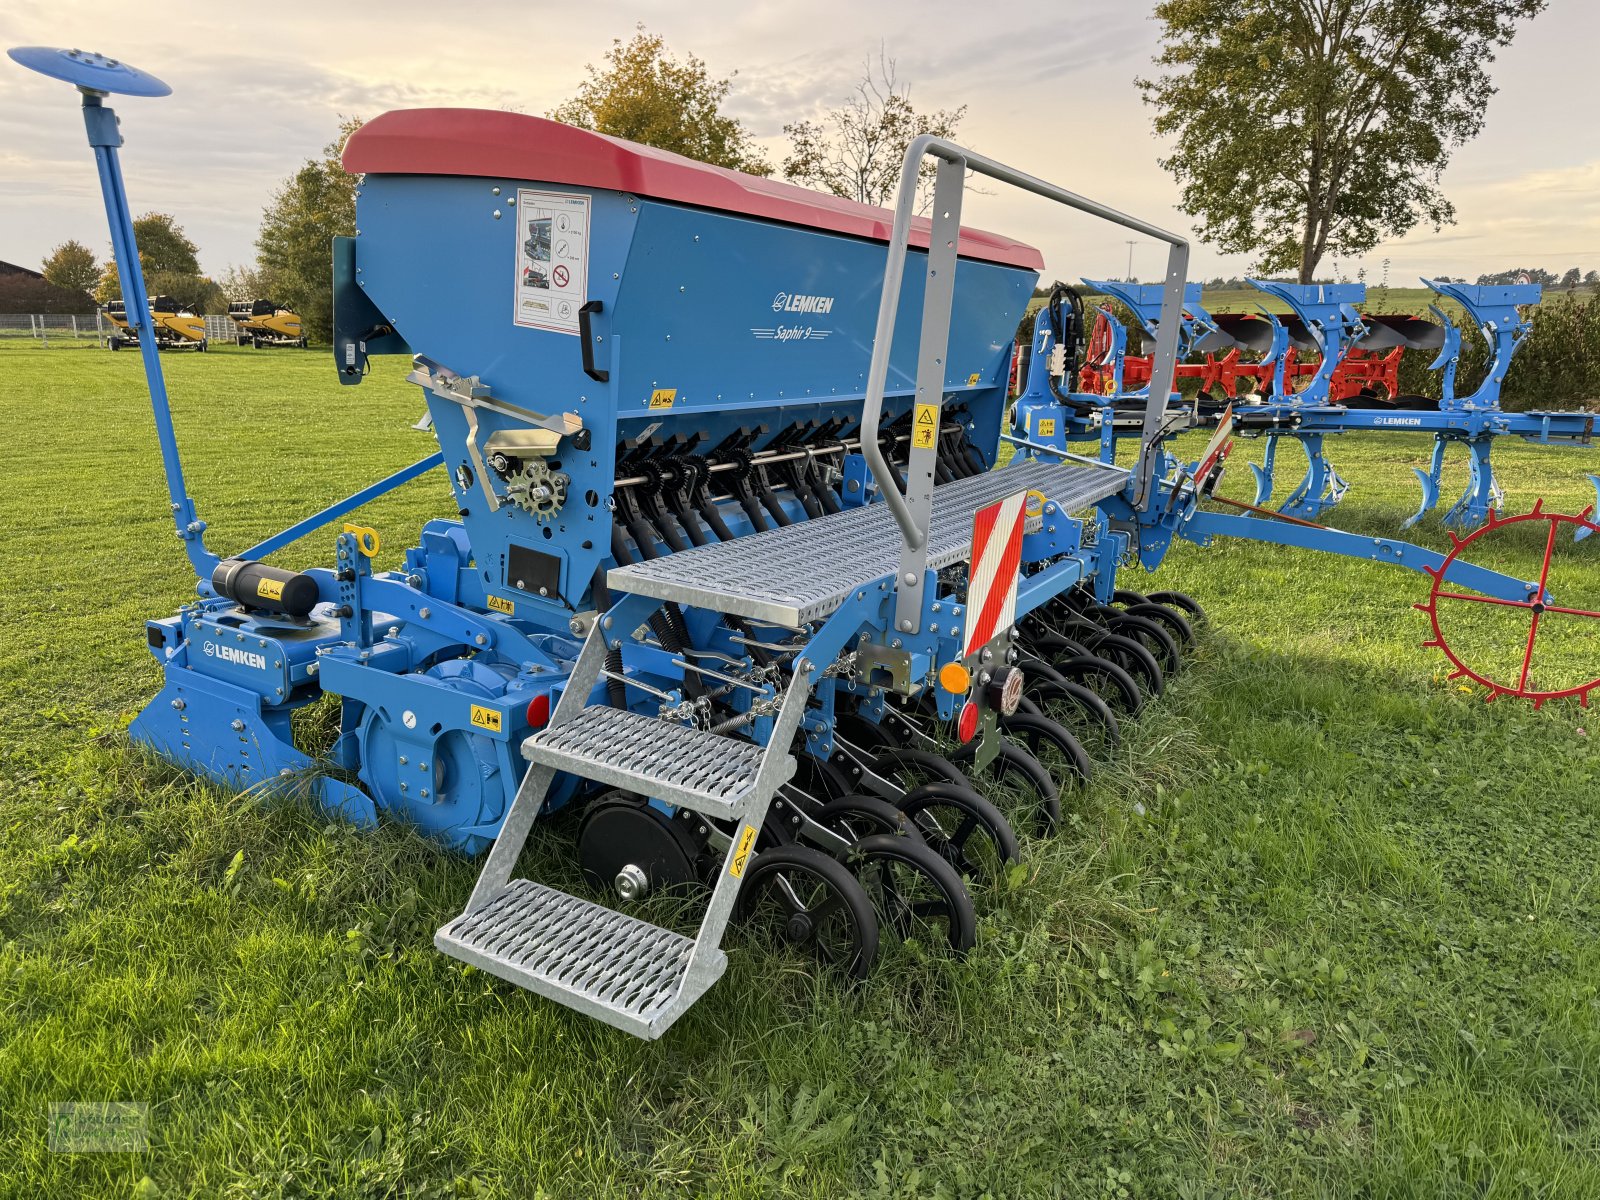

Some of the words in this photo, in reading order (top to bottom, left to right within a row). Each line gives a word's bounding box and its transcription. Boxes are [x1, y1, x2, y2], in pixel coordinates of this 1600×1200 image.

[784, 294, 834, 315] LEMKEN
[774, 325, 805, 342] Saphir
[803, 326, 812, 340] 9
[1383, 417, 1421, 426] LEMKEN
[215, 644, 266, 670] LEMKEN
